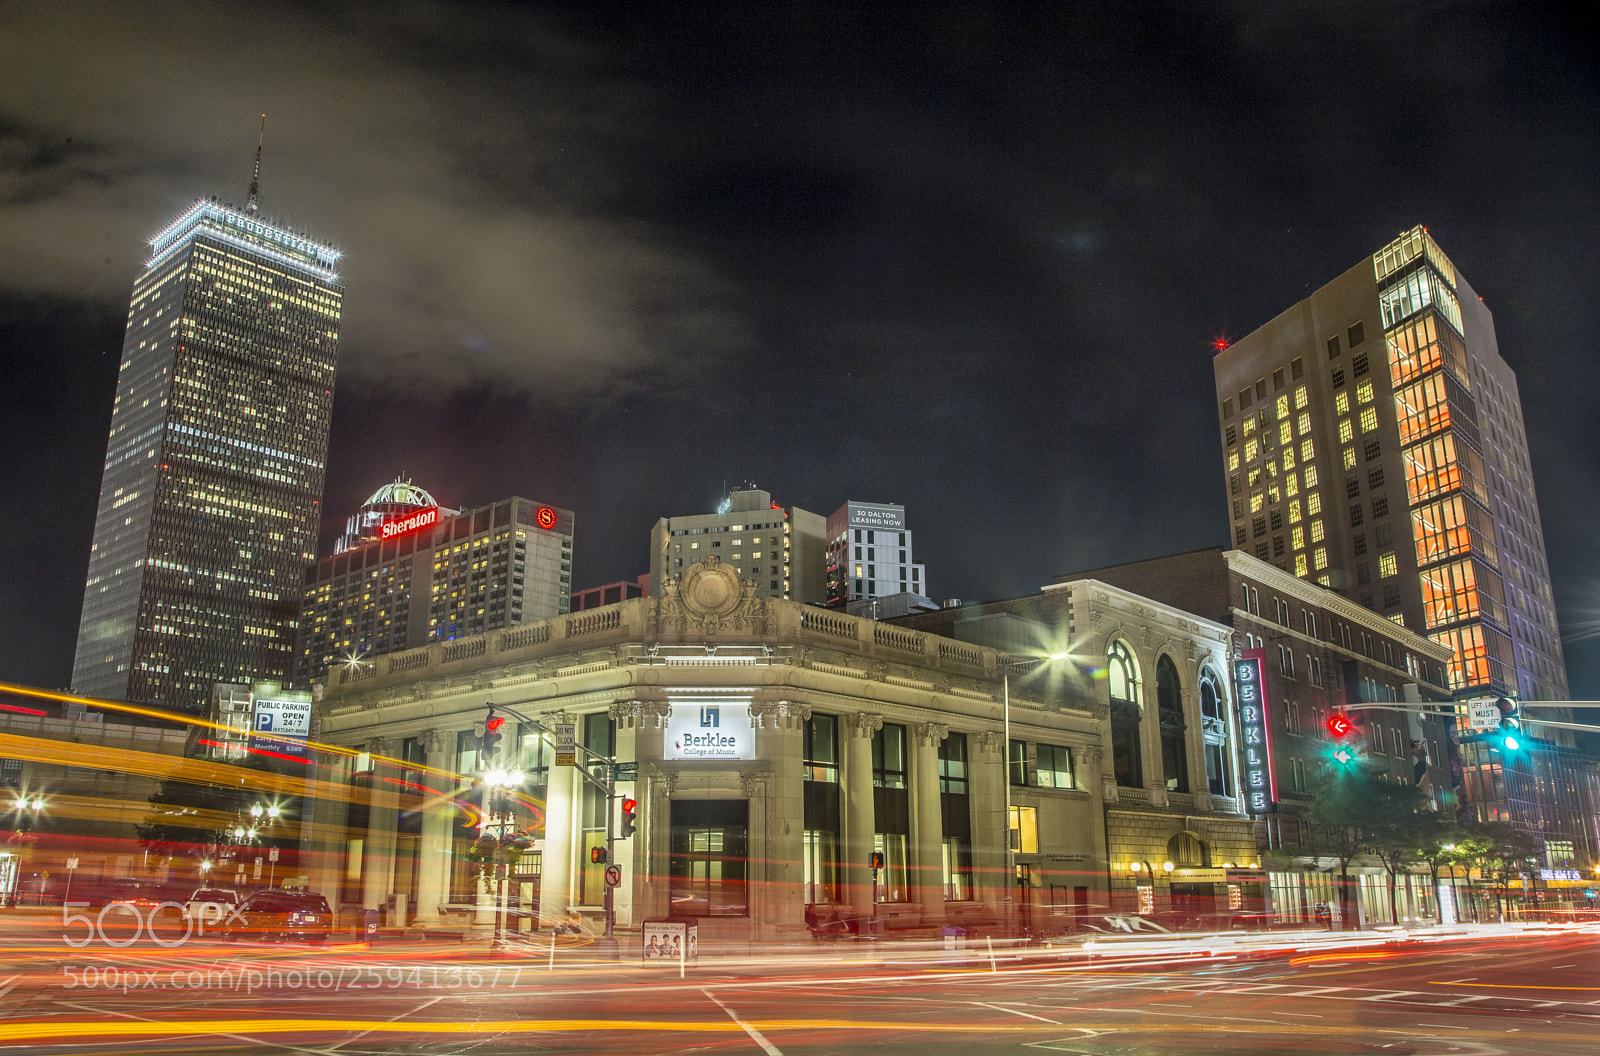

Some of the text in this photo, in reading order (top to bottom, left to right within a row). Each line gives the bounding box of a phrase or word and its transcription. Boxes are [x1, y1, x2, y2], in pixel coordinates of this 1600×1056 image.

[228, 214, 316, 255] PRUDENTIAL
[868, 511, 896, 519] DALTON
[382, 510, 436, 538] Sheraton
[851, 516, 882, 525] LEASING
[257, 701, 310, 712] PUBLIC PARKING
[282, 712, 304, 720] OPEN
[1475, 709, 1495, 718] MUST
[257, 713, 271, 730] P
[282, 719, 303, 727] 24/7
[1473, 718, 1500, 727] TURN LEFT
[564, 727, 575, 735] NOT
[557, 736, 574, 745] BLOCK
[683, 732, 736, 747] Berklee
[1240, 666, 1264, 808] BERKLEE
[254, 743, 281, 752] Monthly
[683, 748, 704, 757] College
[715, 748, 736, 756] Music
